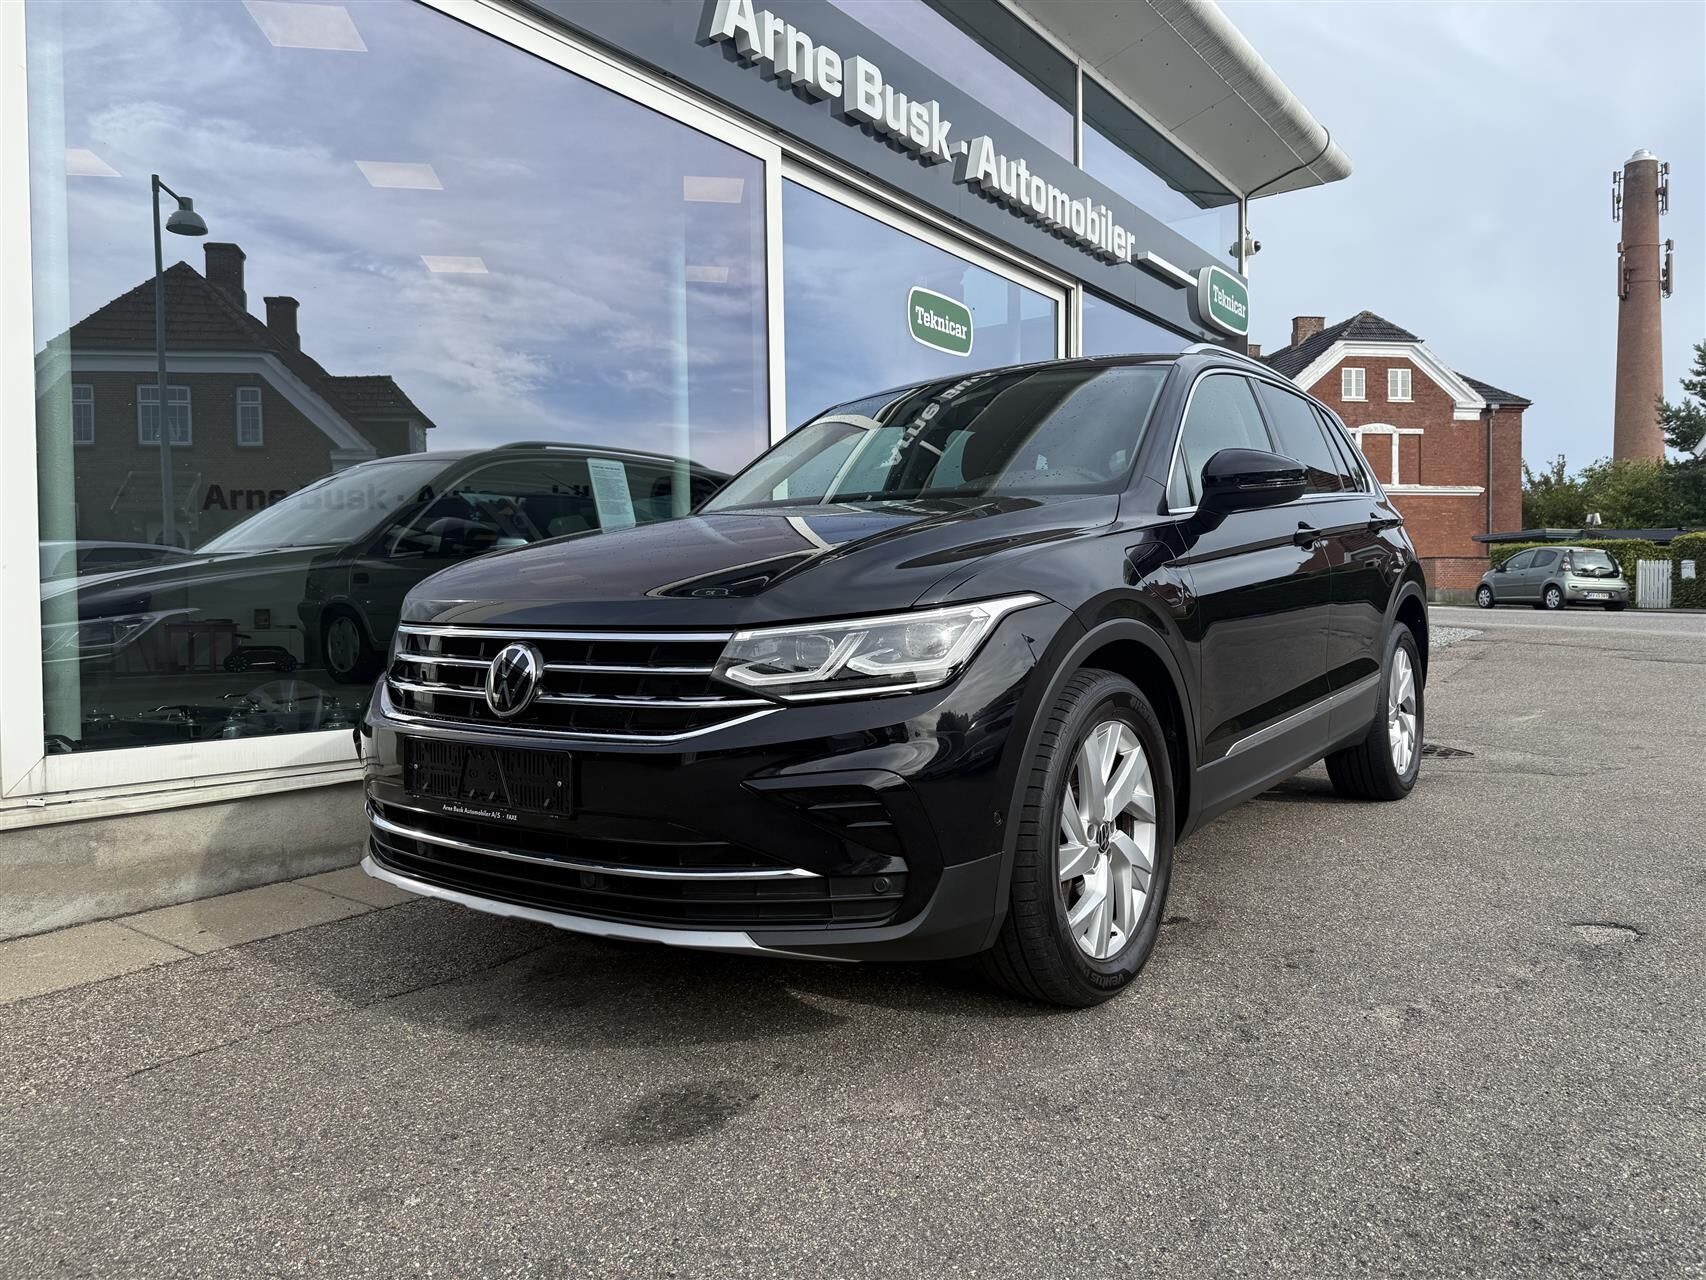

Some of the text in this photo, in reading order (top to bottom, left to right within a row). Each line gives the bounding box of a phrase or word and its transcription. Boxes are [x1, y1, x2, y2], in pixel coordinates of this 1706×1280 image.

[711, 0, 1136, 263] Arne Busk Automobiler
[1212, 284, 1247, 319] Teknicar
[915, 305, 968, 340] Teknicar
